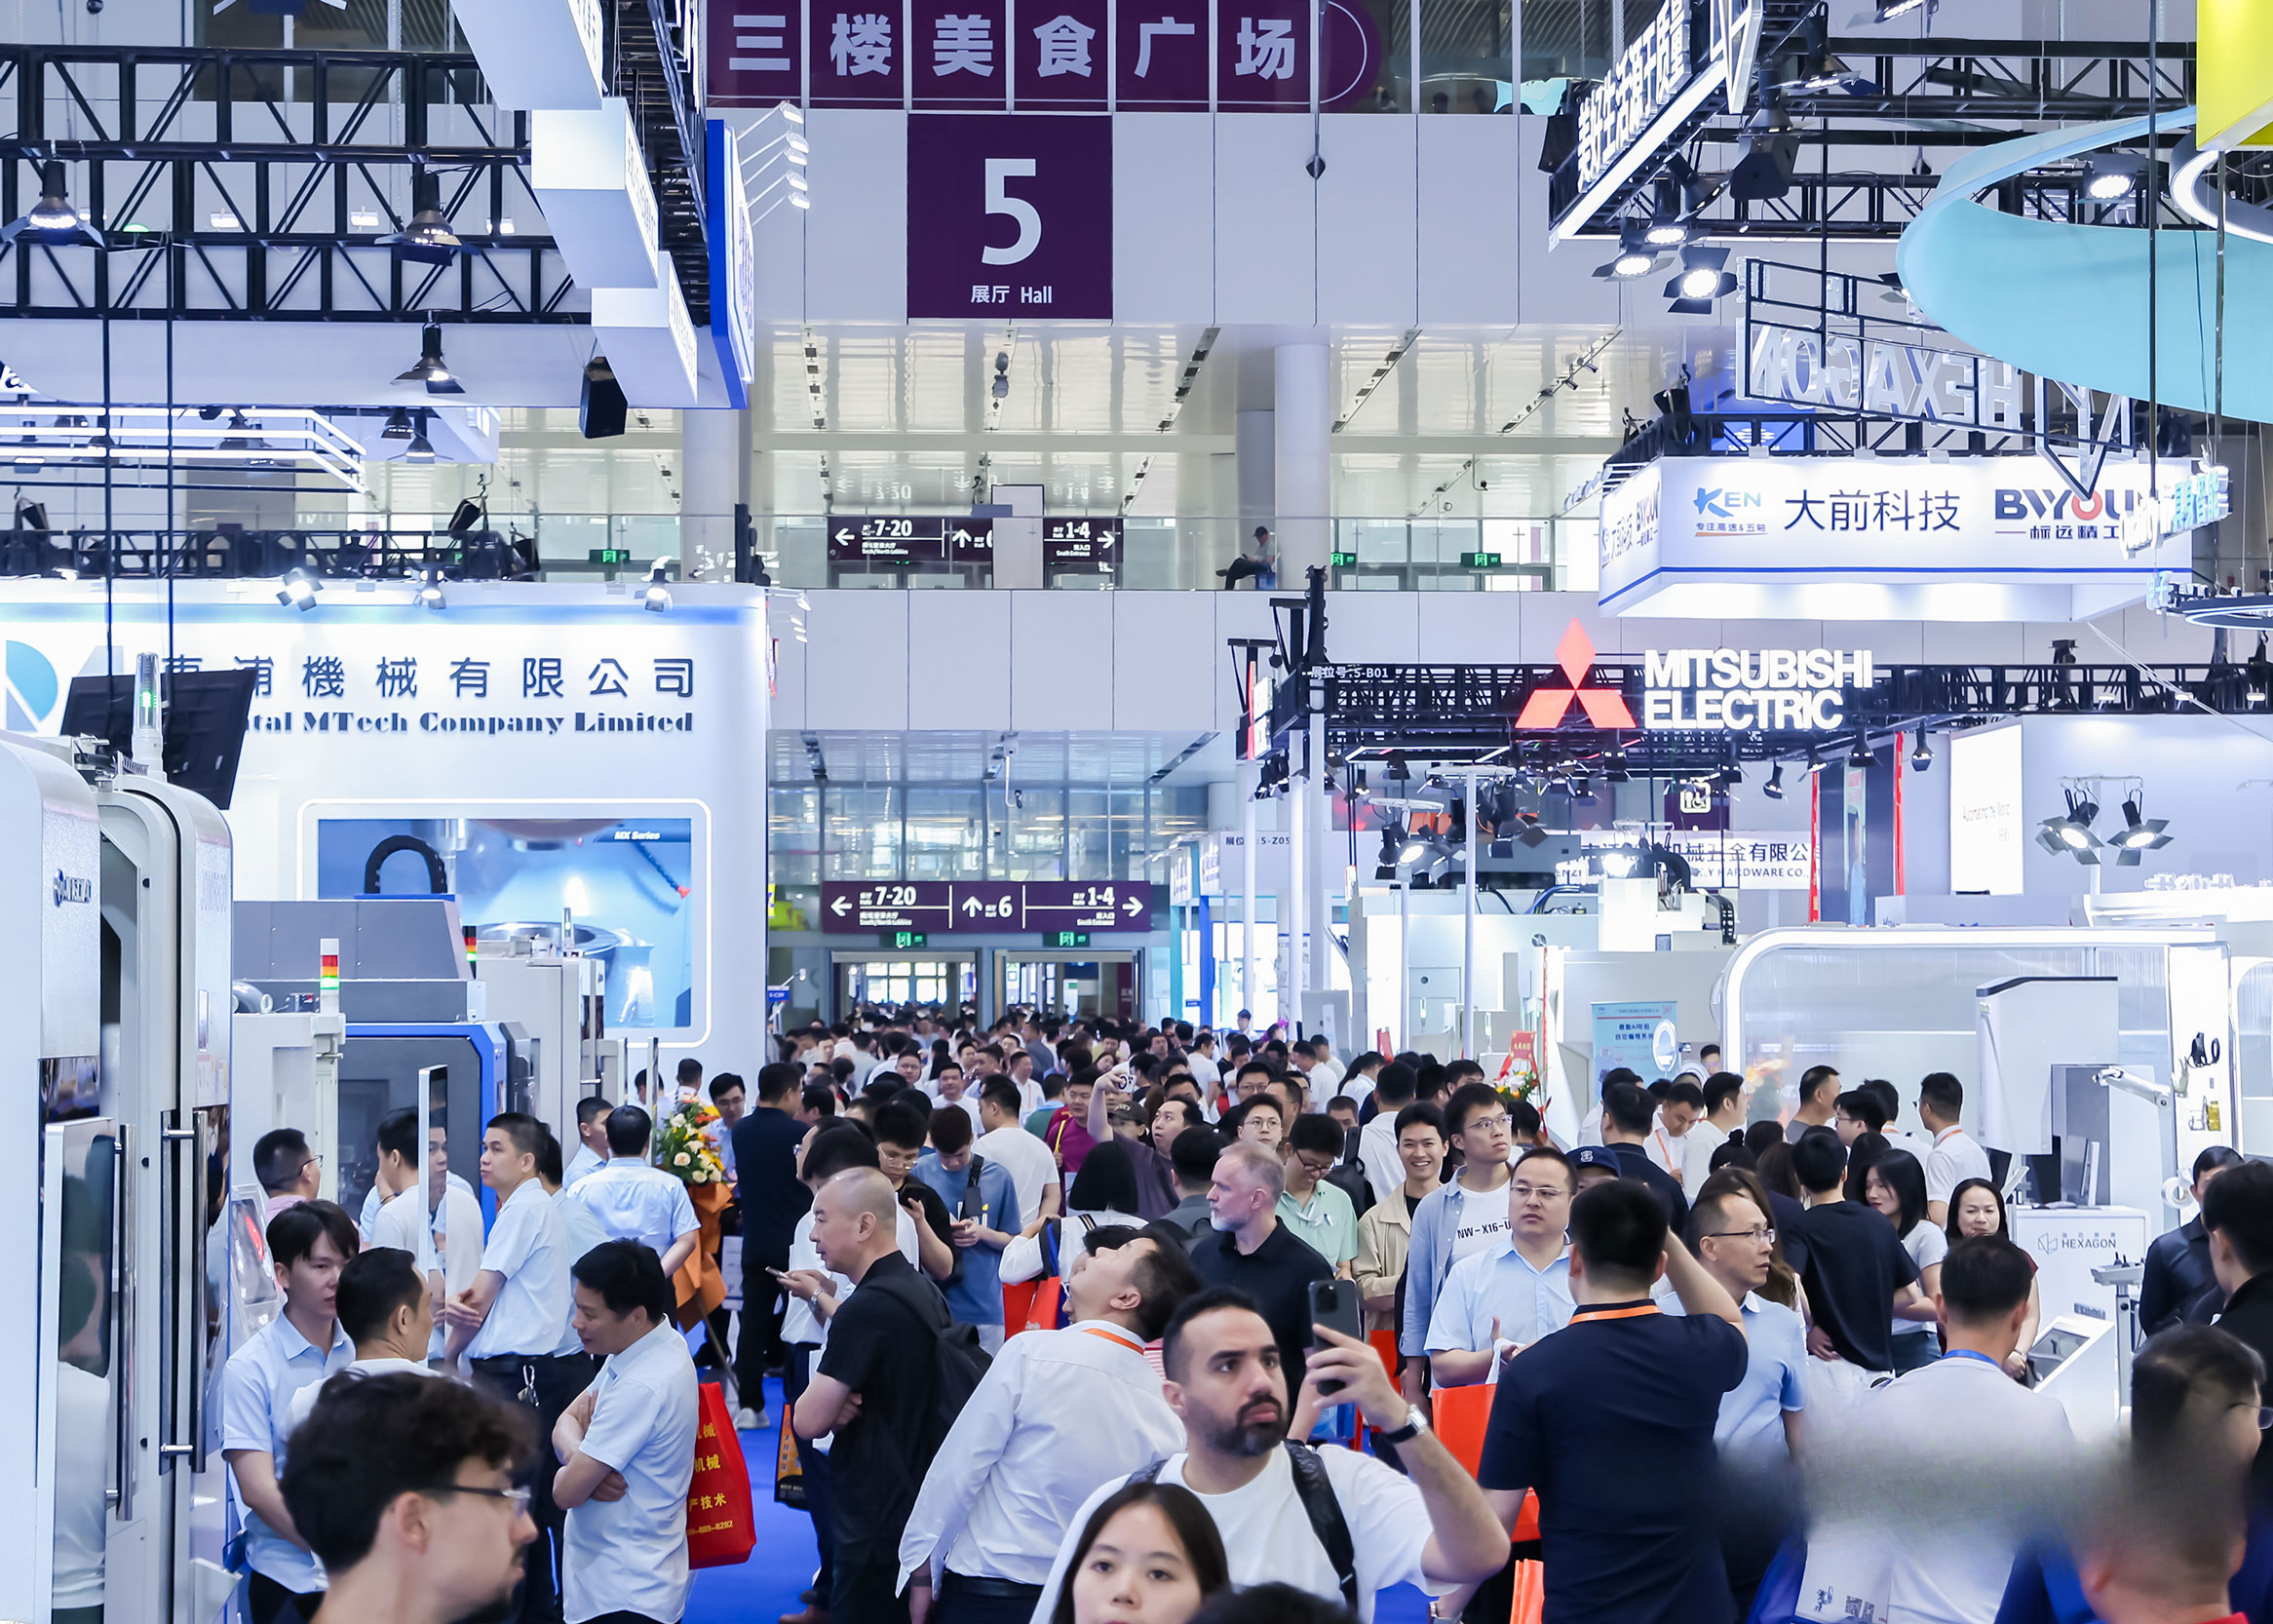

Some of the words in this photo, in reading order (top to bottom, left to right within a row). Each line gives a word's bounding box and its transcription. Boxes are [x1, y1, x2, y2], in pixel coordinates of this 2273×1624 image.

[729, 14, 1296, 80] 三楼美食广场
[981, 158, 1043, 266] 5
[971, 285, 1010, 304] 展厅
[1021, 286, 1053, 304] Hall
[1693, 487, 1761, 518] KEN
[1784, 489, 1960, 531] 大前科技
[874, 520, 913, 537] 7-20
[1065, 522, 1091, 539] 1-4
[1644, 648, 1873, 688] MITSUBISHI
[1644, 689, 1844, 730] ELECTRIC
[304, 712, 407, 731] MTech
[420, 712, 565, 735] Company
[575, 712, 693, 732] Limited
[874, 885, 917, 906] 7-20
[998, 895, 1013, 918] 6
[1088, 886, 1115, 906] 1-4
[2061, 1239, 2116, 1249] HEXAGON
